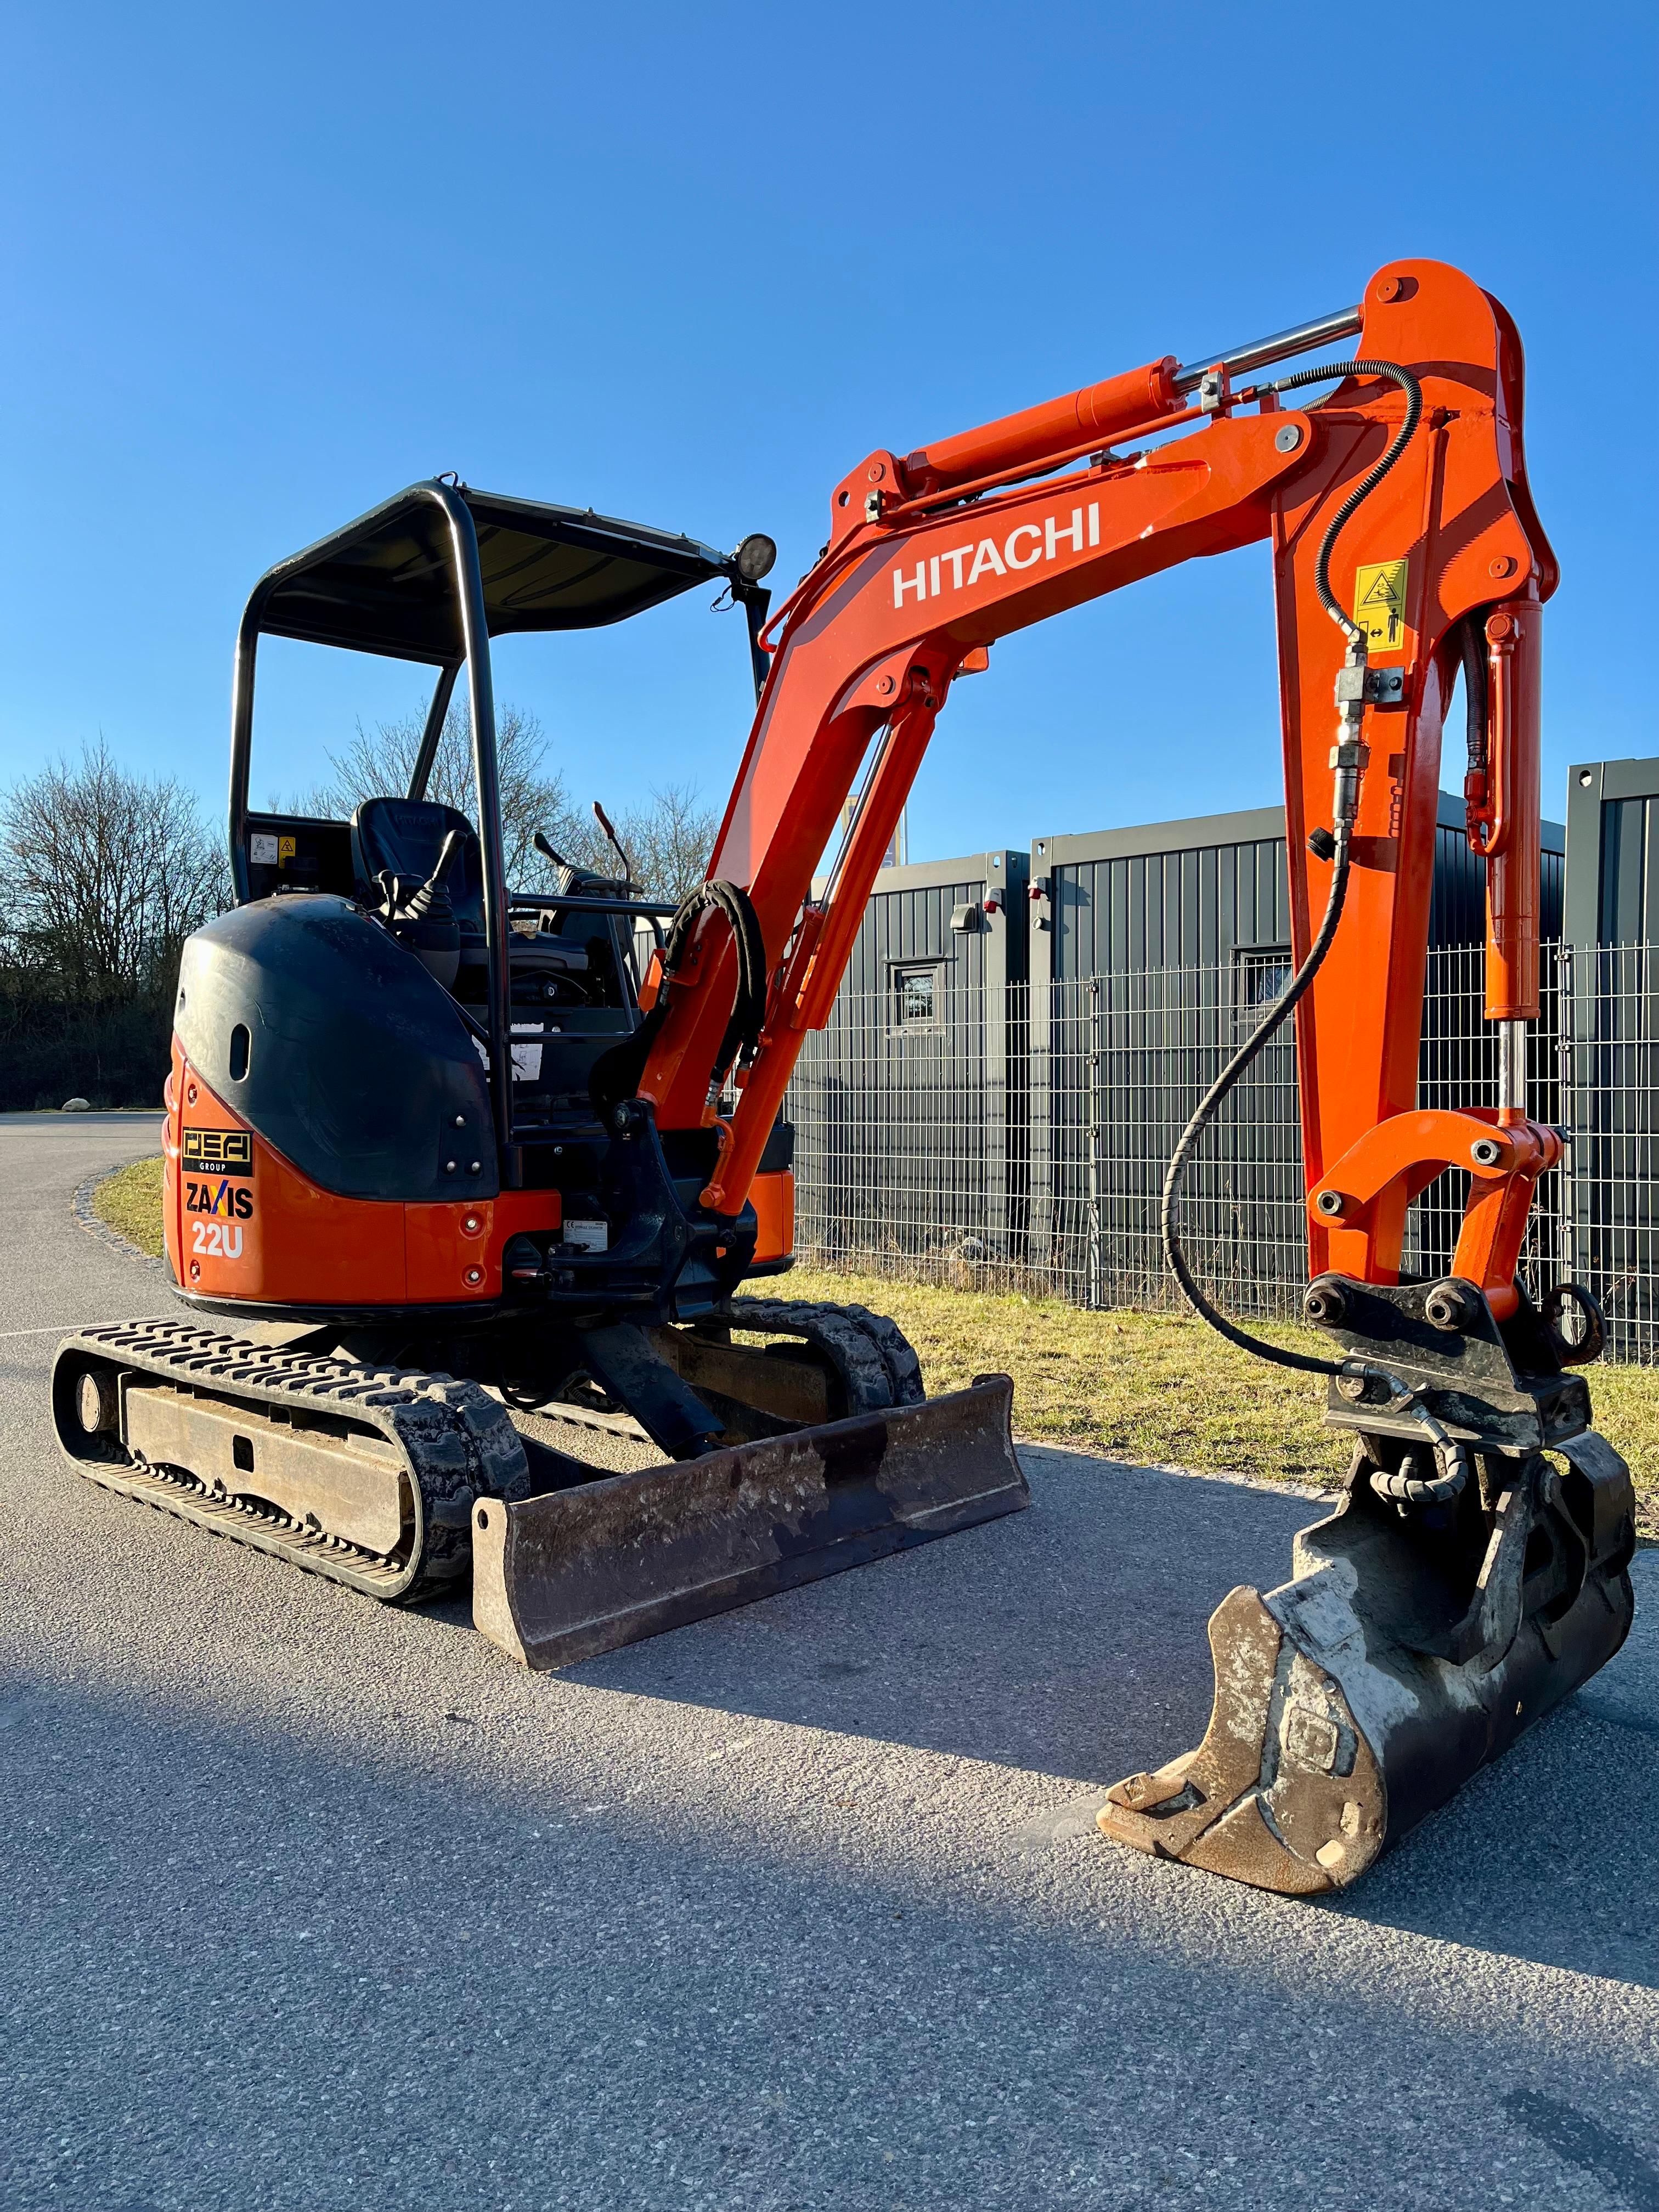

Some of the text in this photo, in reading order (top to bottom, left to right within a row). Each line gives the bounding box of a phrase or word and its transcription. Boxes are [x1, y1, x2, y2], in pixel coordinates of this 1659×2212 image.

[893, 501, 1100, 609] HITACHI
[200, 1162, 225, 1172] GROUP
[187, 1179, 253, 1220] ZAXIS
[192, 1221, 244, 1259] 22U
